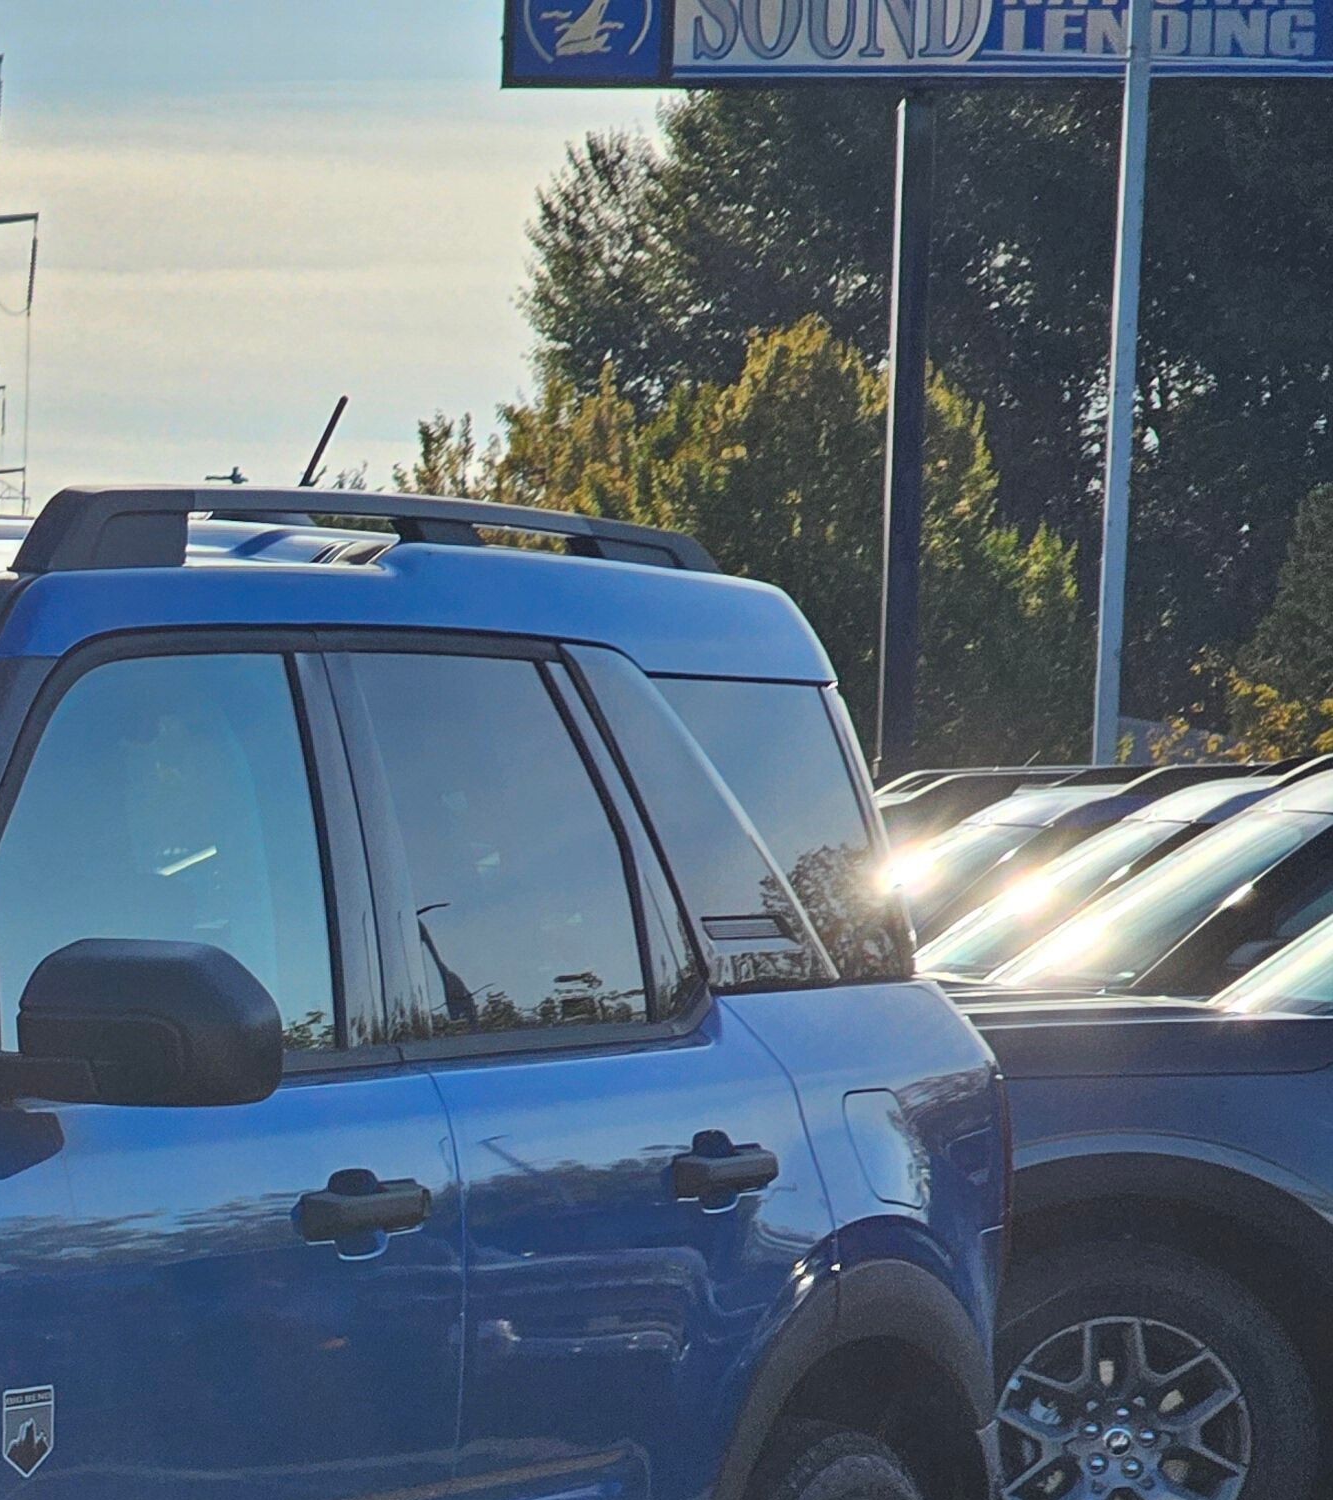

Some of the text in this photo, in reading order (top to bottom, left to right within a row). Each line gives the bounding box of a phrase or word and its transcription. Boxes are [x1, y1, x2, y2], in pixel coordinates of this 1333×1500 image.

[1003, 9, 1316, 57] LENDING
[5, 1391, 52, 1405] BIG BEND
